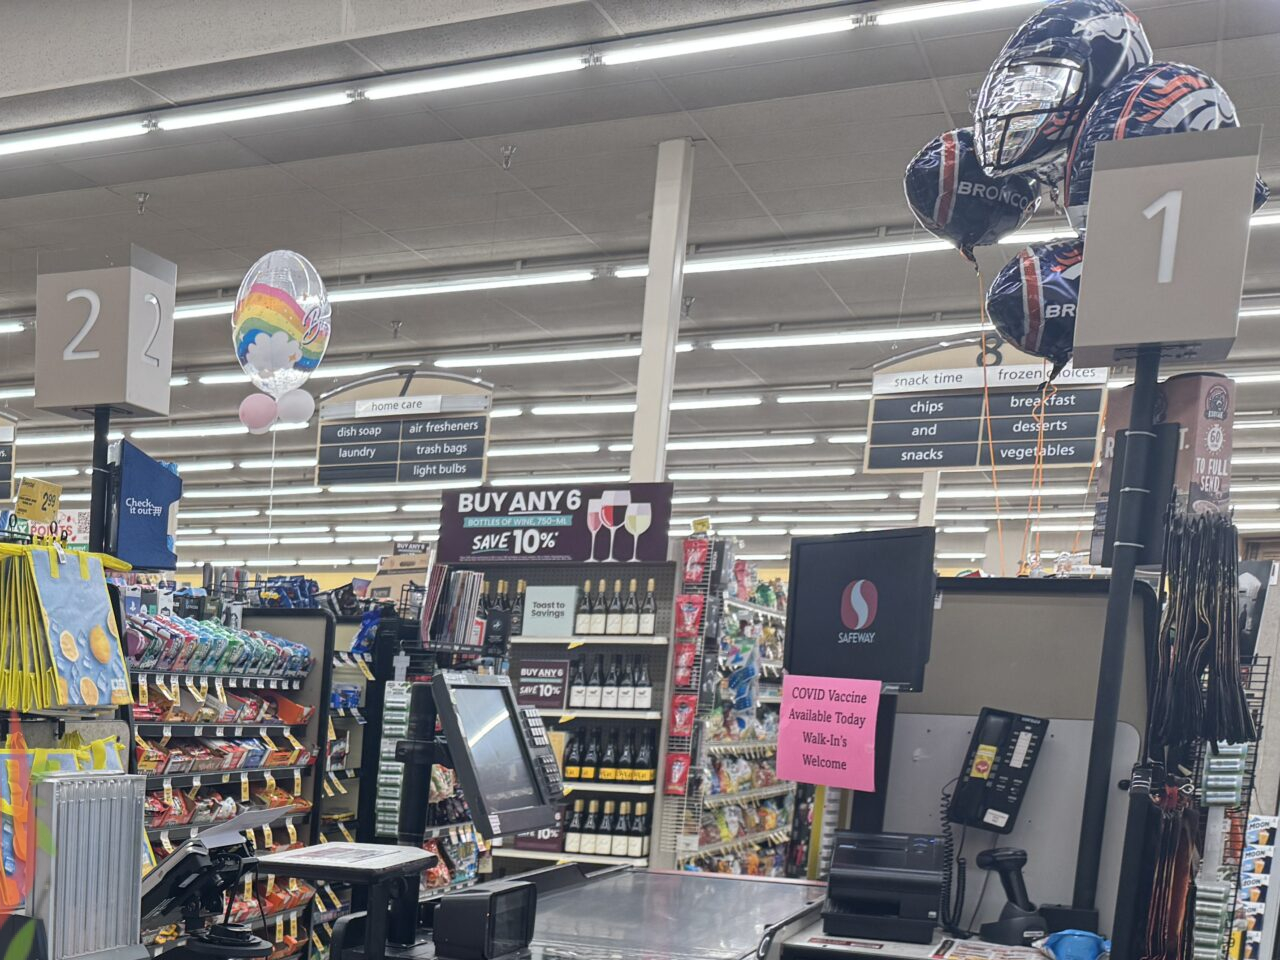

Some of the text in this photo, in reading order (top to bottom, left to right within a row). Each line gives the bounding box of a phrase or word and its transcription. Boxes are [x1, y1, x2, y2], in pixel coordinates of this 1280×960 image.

[1142, 190, 1183, 284] 1
[63, 288, 101, 361] 2
[142, 293, 162, 367] 2
[894, 372, 962, 387] snack time
[999, 369, 1042, 381] frozen
[372, 401, 422, 411] home care
[910, 401, 944, 413] chips
[337, 426, 382, 438] dish soap
[409, 420, 479, 433] air fresheners
[911, 424, 937, 436] and
[1013, 420, 1068, 433] desserts
[1210, 430, 1220, 443] 60
[338, 447, 376, 459] laundry
[417, 443, 468, 455] trash bags
[901, 449, 944, 461] snacks
[1000, 445, 1075, 459] vegetables
[413, 463, 467, 477] light bulbs
[1196, 457, 1228, 476] TO FULL
[1200, 475, 1220, 492] SEND
[125, 498, 152, 508] Check
[458, 489, 581, 512] BUY ANY 6
[137, 507, 152, 515] out
[468, 519, 500, 527] BOTTLES
[502, 518, 511, 526] OF
[472, 532, 511, 550] SAVE
[531, 609, 565, 618] Savings
[838, 632, 875, 643] SAFEWAY
[538, 669, 557, 677] ANY
[558, 668, 563, 676] 6
[520, 685, 538, 695] SAVE
[792, 686, 867, 704] COVID Vaccine
[788, 708, 866, 728] Available Today
[803, 731, 847, 748] Walk-In's
[802, 754, 847, 770] Welcome
[1249, 821, 1269, 831] MOON
[1245, 850, 1265, 859] MOON
